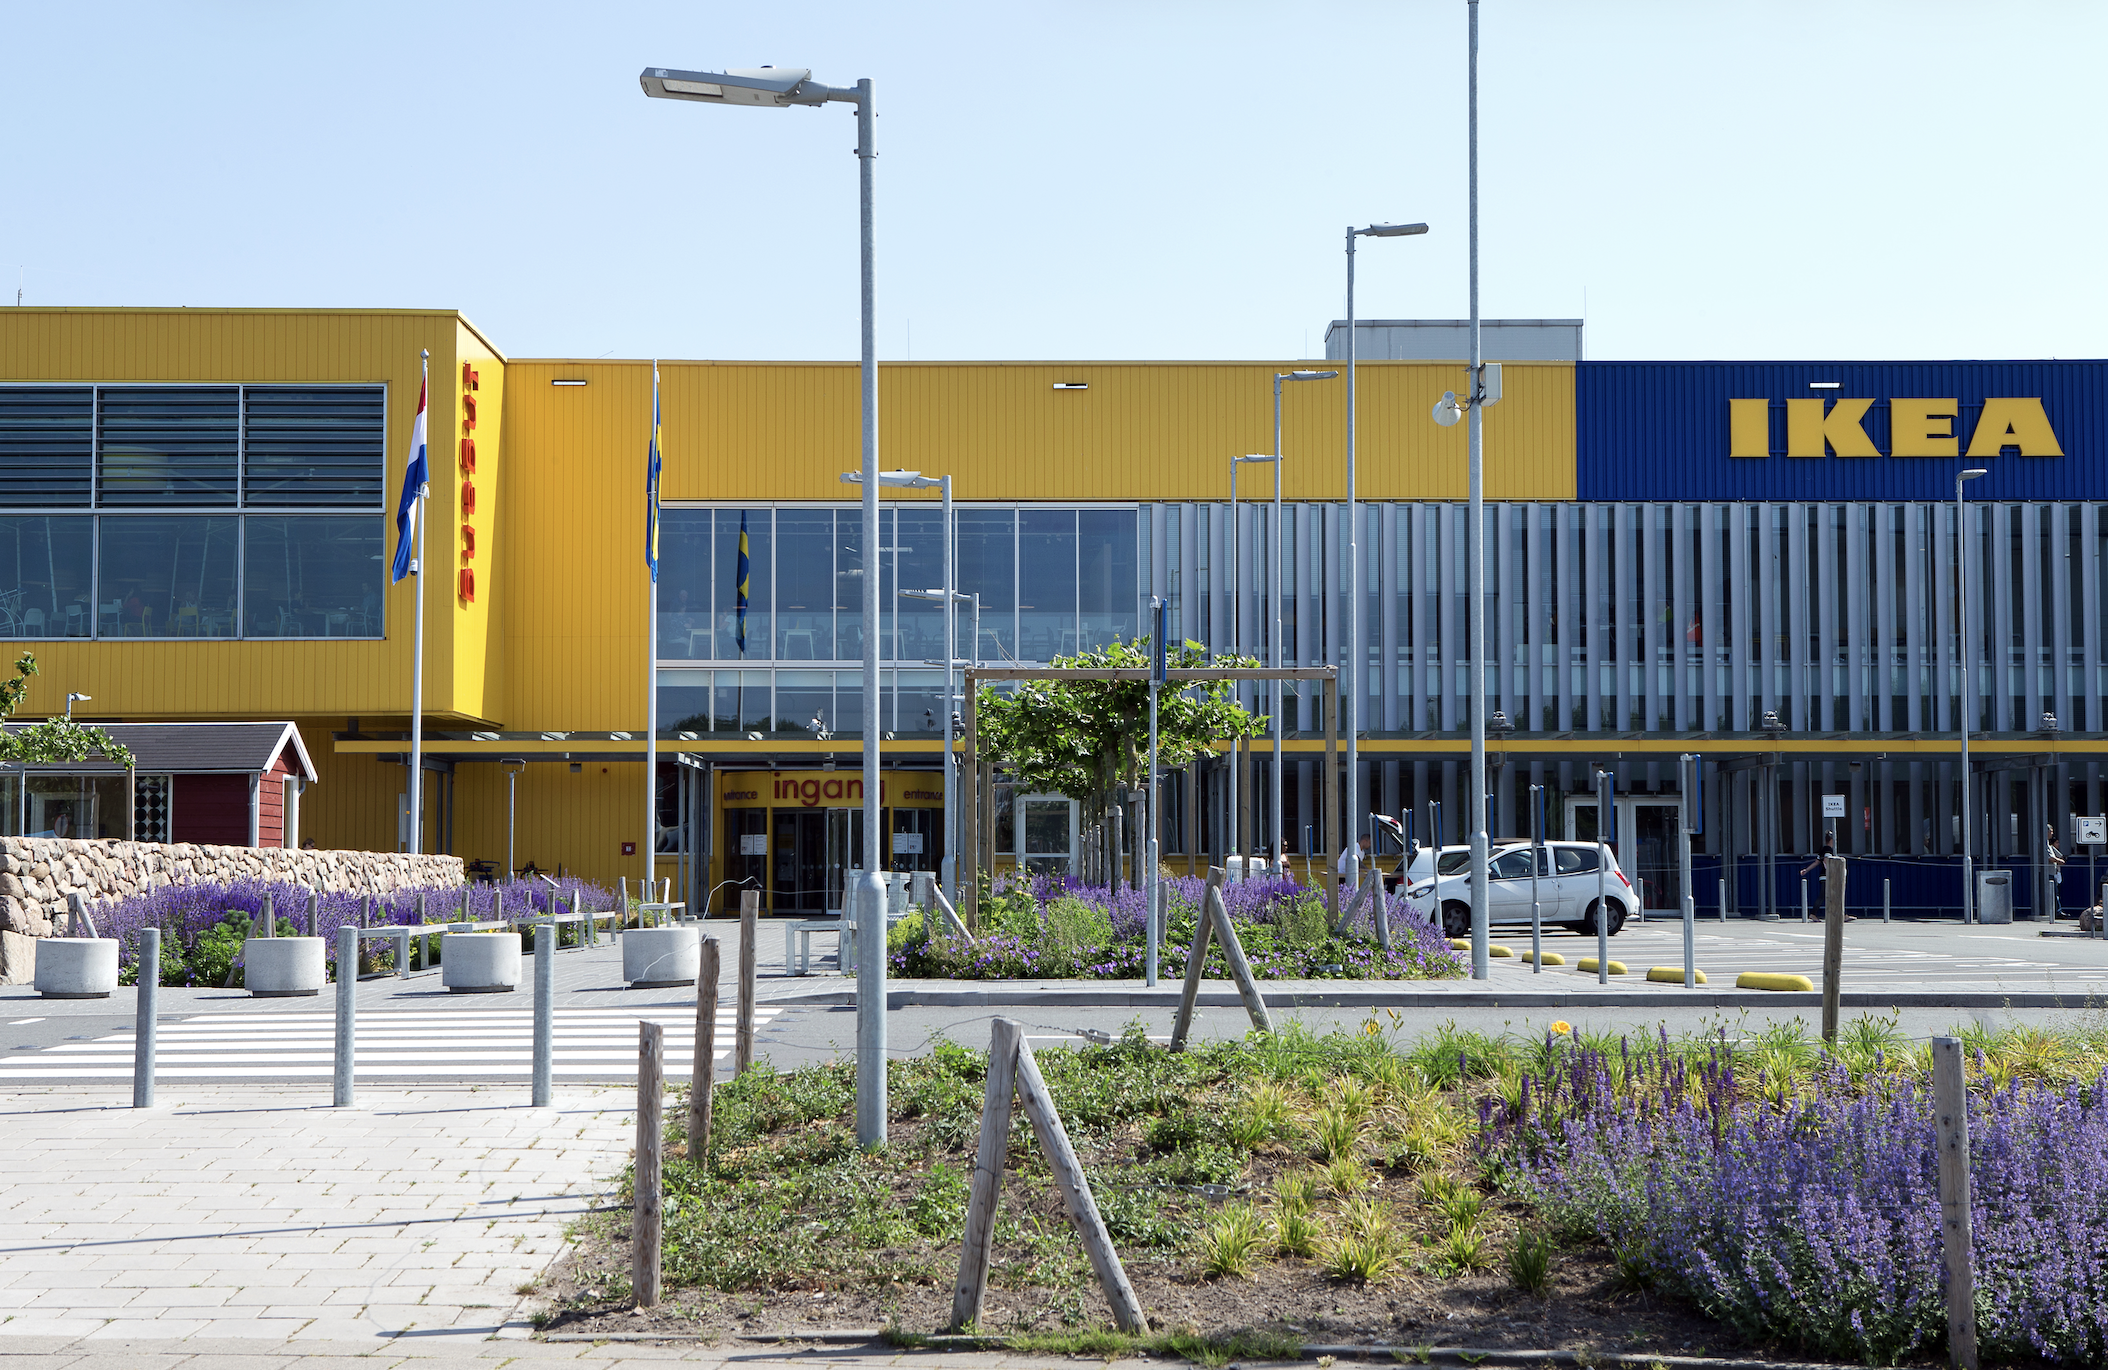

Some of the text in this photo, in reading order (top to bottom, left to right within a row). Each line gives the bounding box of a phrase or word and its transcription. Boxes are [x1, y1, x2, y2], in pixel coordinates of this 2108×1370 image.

[1729, 398, 2065, 458] IKEA
[774, 772, 885, 807] ingan
[903, 788, 943, 801] entrance
